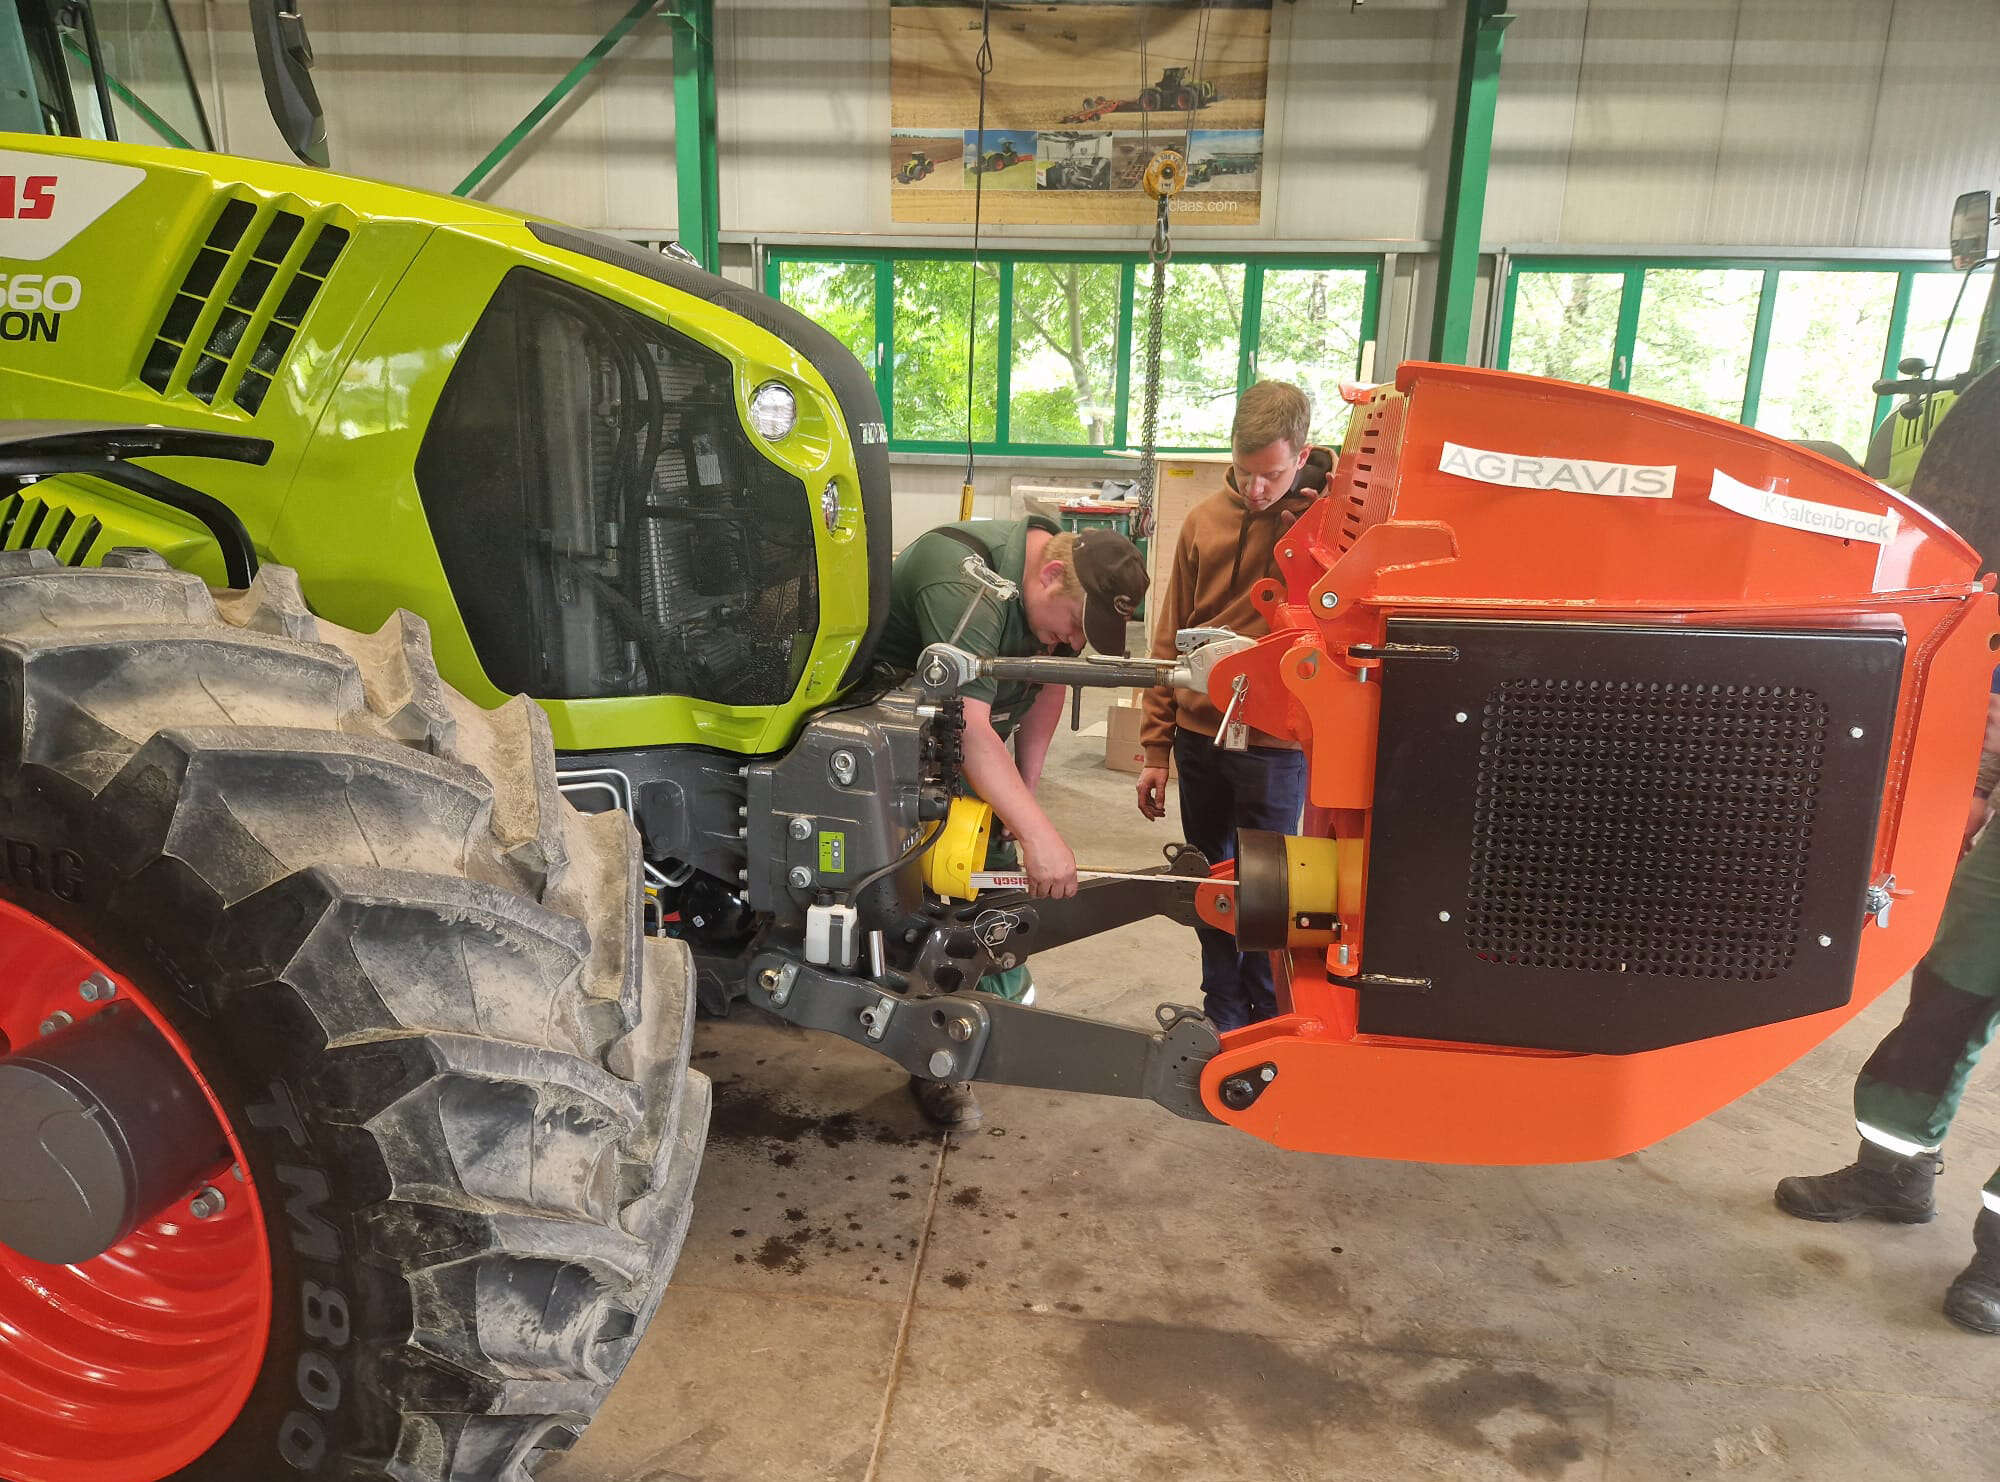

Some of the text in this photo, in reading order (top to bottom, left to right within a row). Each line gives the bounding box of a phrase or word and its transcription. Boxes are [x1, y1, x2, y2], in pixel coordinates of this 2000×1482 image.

[1168, 199, 1238, 212] claas.com
[0, 273, 82, 312] 60
[0, 311, 61, 343] ON
[1442, 447, 1669, 495] AGRAVIS
[1782, 500, 1891, 539] Saltenbrock
